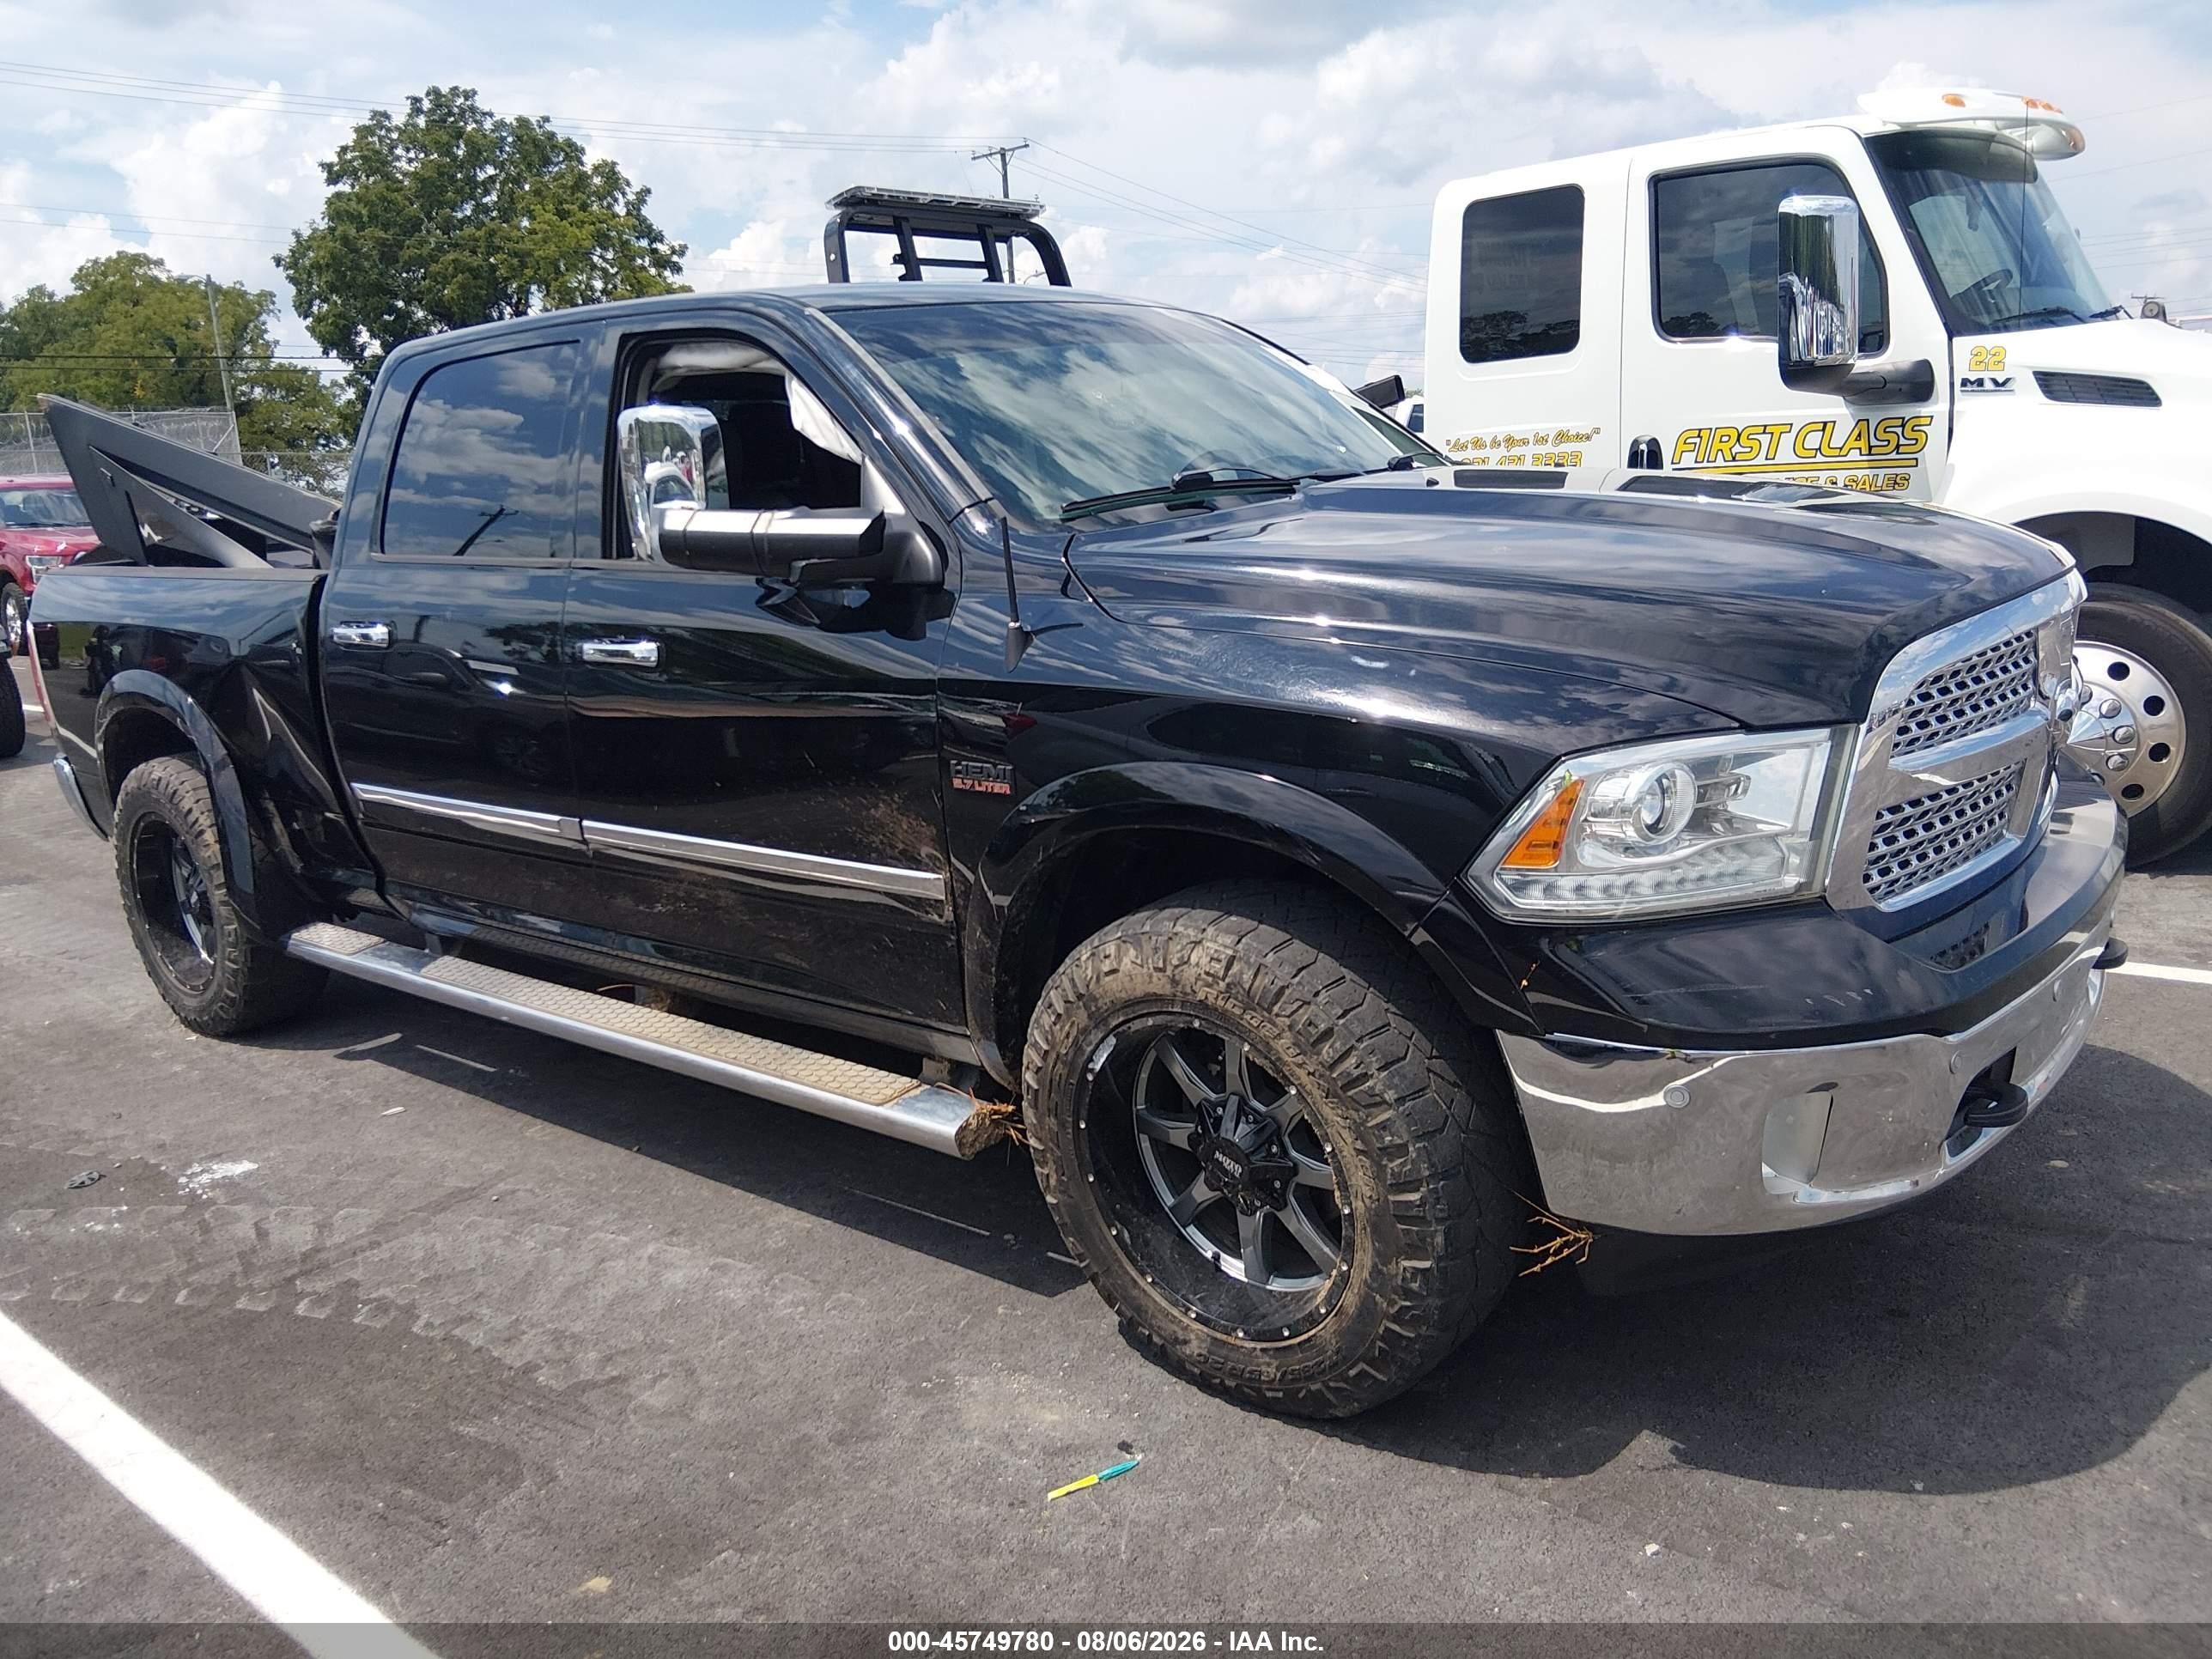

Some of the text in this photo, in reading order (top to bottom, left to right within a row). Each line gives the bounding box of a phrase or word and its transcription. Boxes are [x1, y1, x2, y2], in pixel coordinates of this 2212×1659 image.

[1969, 345, 2007, 371] 22
[1960, 377, 2015, 388] MV
[1445, 428, 1601, 453] "Let Us be Your 1st Choice!"
[1671, 416, 1934, 465] FIRST CLASS
[1844, 473, 1911, 492] SALES
[949, 760, 1014, 782] HEMI
[975, 780, 1011, 795] LITER
